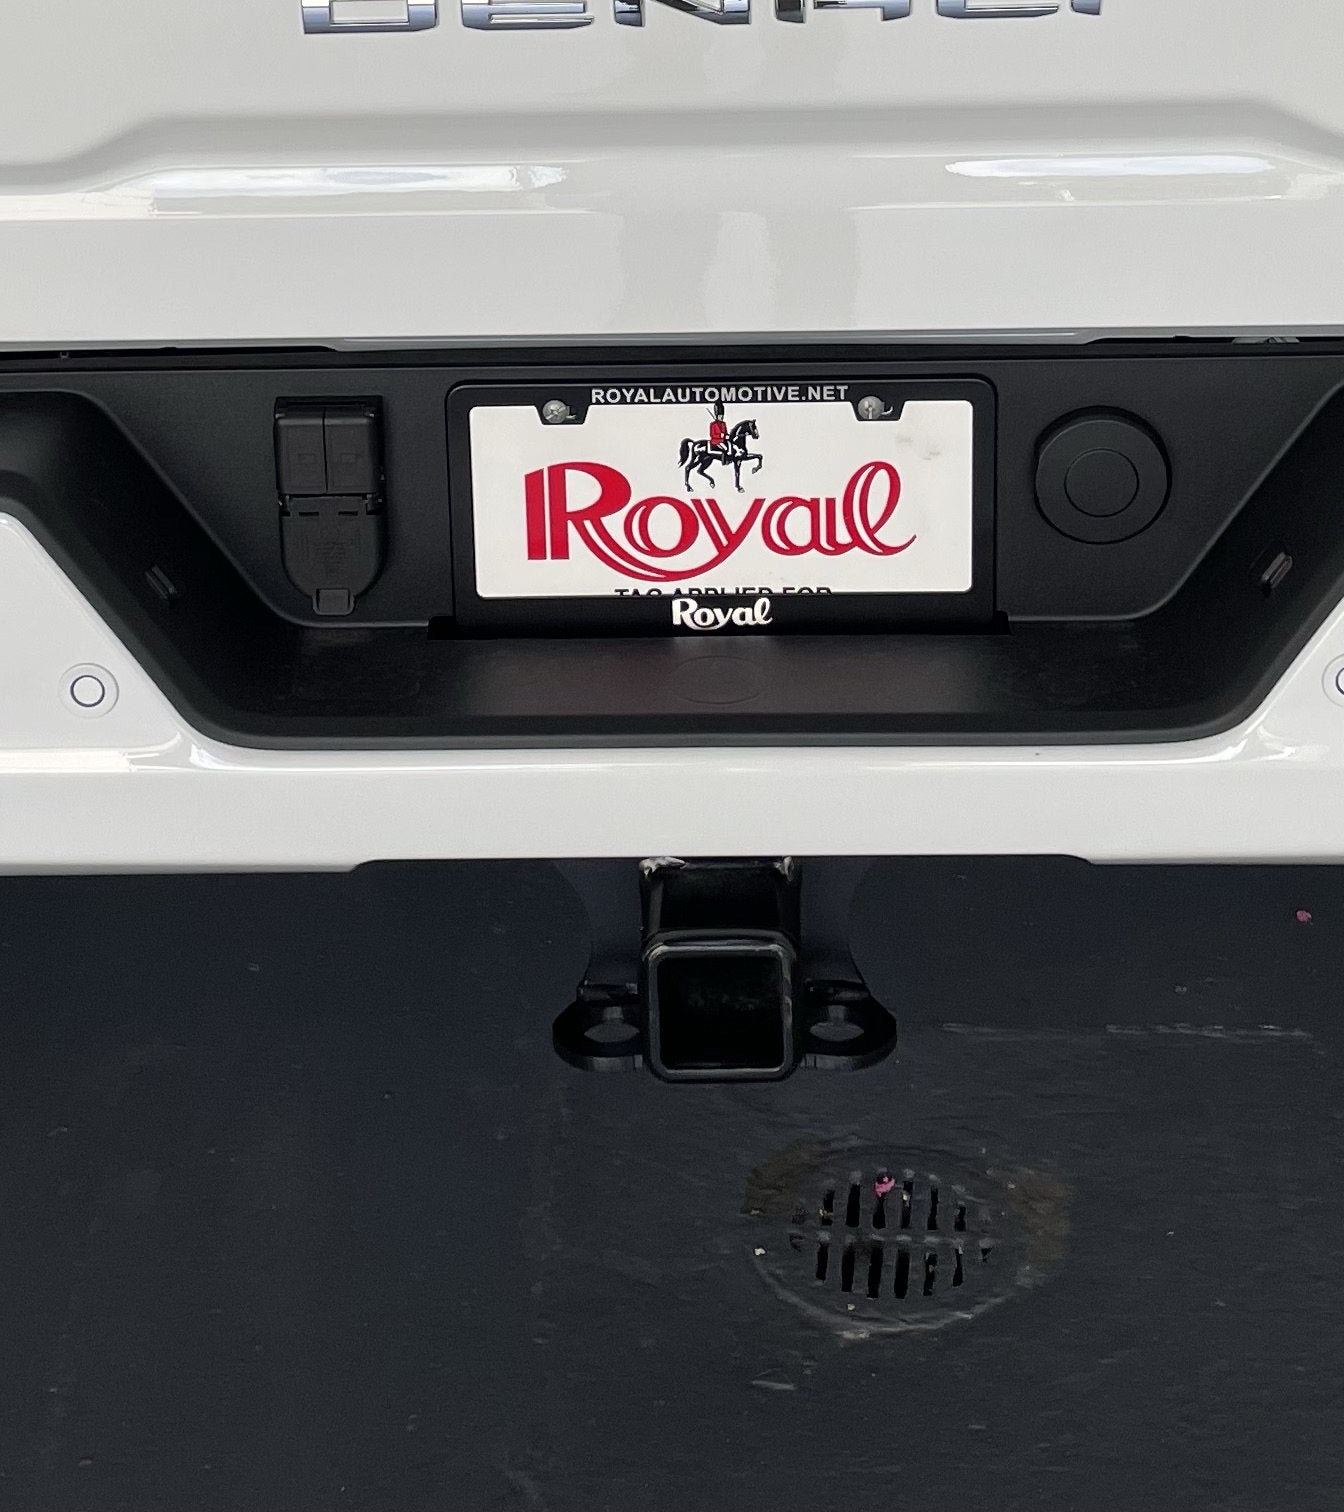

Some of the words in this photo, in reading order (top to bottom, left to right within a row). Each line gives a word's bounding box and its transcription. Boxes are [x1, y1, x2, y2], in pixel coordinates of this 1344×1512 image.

[591, 385, 849, 403] ROYALAUTOMOTIVE.NET
[524, 461, 917, 582] Royal
[671, 597, 773, 631] Royal
